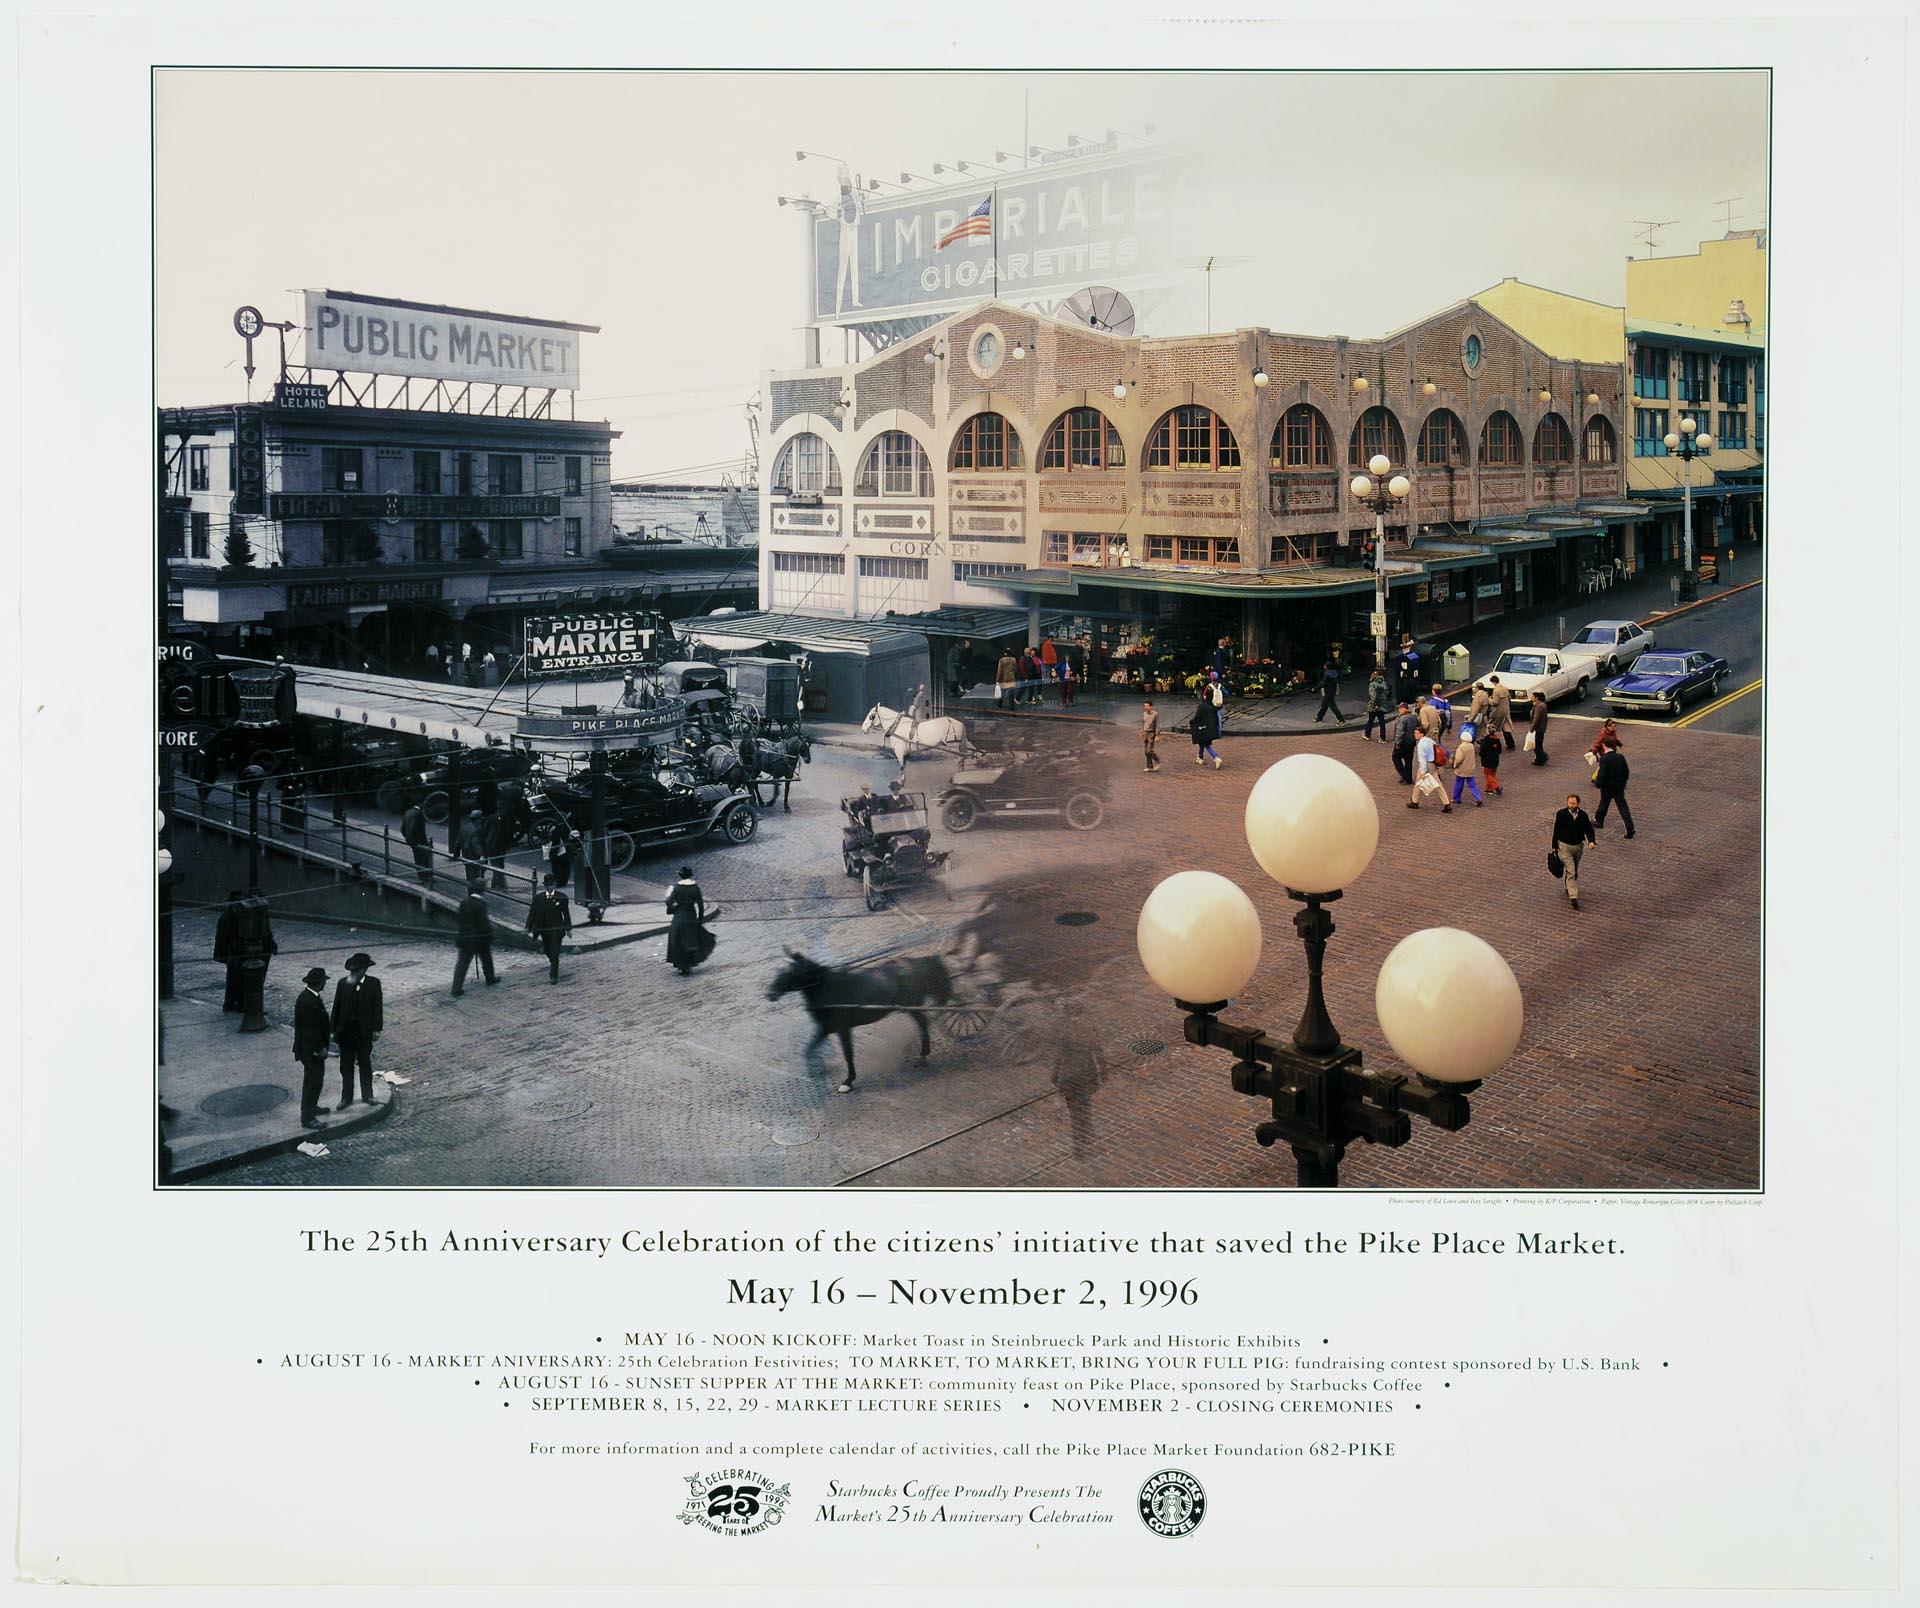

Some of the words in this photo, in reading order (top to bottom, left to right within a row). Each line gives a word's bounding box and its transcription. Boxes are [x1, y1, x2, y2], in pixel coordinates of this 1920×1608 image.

[874, 165, 1197, 275] IMPERIALE
[920, 237, 1140, 293] CIGARETTES
[316, 305, 438, 361] PUBLIC
[448, 322, 572, 374] MARKET
[285, 387, 324, 397] HOTEL
[280, 397, 326, 409] LELAND
[889, 540, 981, 558] CORNER
[551, 617, 634, 634] PUBLIC
[532, 629, 655, 658] MARKET
[158, 646, 193, 661] RUG
[541, 651, 644, 669] ENTRANCE
[240, 685, 273, 696] DRUG
[572, 720, 607, 733] PIKE
[158, 731, 198, 746] TORE
[1512, 1197, 1536, 1205] Printing
[1558, 1197, 1590, 1205] Corporation
[1620, 1197, 1641, 1205] Vintage
[299, 1229, 355, 1252] The
[366, 1229, 428, 1253] 25th
[439, 1229, 612, 1259] Anniversary
[621, 1228, 785, 1253] Celebration
[795, 1229, 826, 1253] of
[832, 1229, 877, 1253] the
[887, 1230, 1002, 1253] citizens’
[1012, 1230, 1139, 1254] initiative
[1149, 1230, 1206, 1254] that
[1215, 1230, 1293, 1254] saved
[1303, 1231, 1348, 1254] the
[1357, 1230, 1421, 1254] Pike
[1431, 1231, 1506, 1255] Place
[1515, 1231, 1625, 1255] Market.
[725, 1278, 795, 1313] May
[809, 1276, 846, 1305] 16
[887, 1277, 1066, 1306] November
[1078, 1279, 1107, 1311] 2,
[1122, 1277, 1199, 1309] 1996
[624, 1332, 668, 1346] MAY
[676, 1331, 695, 1346] 16
[712, 1333, 766, 1347] NOON
[772, 1333, 857, 1347] KICKOFF:
[863, 1333, 918, 1347] Market
[922, 1334, 965, 1347] Toast
[971, 1334, 985, 1347] in
[991, 1333, 1085, 1348] Steinbrueck
[1091, 1334, 1128, 1347] Park
[1133, 1334, 1161, 1348] and
[1167, 1334, 1231, 1348] Historic
[1236, 1334, 1301, 1348] Exhibits
[280, 1353, 365, 1368] AUGUST
[373, 1352, 391, 1368] 16
[408, 1354, 485, 1368] MARKET
[491, 1354, 612, 1368] ANIVERSARY:
[617, 1354, 652, 1368] 25th
[657, 1354, 748, 1368] Celebration
[754, 1354, 839, 1370] Festivities;
[848, 1355, 874, 1369] TO
[879, 1355, 960, 1370] MARKET,
[964, 1355, 990, 1369] TO
[996, 1356, 1076, 1371] MARKET,
[1081, 1356, 1140, 1369] BRING
[1145, 1356, 1197, 1369] YOUR
[1202, 1356, 1248, 1370] FULL
[1253, 1356, 1289, 1370] PIG:
[1295, 1355, 1385, 1374] fundraising
[1390, 1360, 1447, 1370] contest
[1452, 1356, 1532, 1374] sponsored
[1538, 1356, 1556, 1374] by
[1562, 1357, 1594, 1371] U.S.
[1600, 1357, 1641, 1371] Bank
[497, 1375, 583, 1390] AUGUST
[591, 1374, 609, 1390] 16
[625, 1376, 695, 1390] SUNSET
[700, 1376, 768, 1390] SUPPER
[774, 1376, 797, 1390] AT
[801, 1377, 839, 1390] THE
[843, 1376, 923, 1390] MARKET:
[928, 1377, 1017, 1394] community
[1023, 1377, 1059, 1391] feast
[1064, 1381, 1083, 1391] on
[1089, 1377, 1124, 1391] Pike
[1129, 1377, 1176, 1393] Place,
[1181, 1377, 1260, 1395] sponsored
[1266, 1377, 1285, 1395] by
[1289, 1377, 1368, 1392] Starbucks
[1372, 1377, 1423, 1392] Coffee
[531, 1396, 647, 1411] SEPTEMBER
[652, 1397, 668, 1414] 8,
[676, 1397, 700, 1414] 15,
[706, 1397, 732, 1414] 22,
[738, 1397, 759, 1413] 29
[776, 1399, 853, 1412] MARKET
[858, 1399, 938, 1412] LECTURE
[943, 1399, 1002, 1412] SERIES
[1051, 1398, 1164, 1413] NOVEMBER
[1170, 1398, 1179, 1413] 2
[1196, 1399, 1275, 1413] CLOSING
[1280, 1400, 1393, 1414] CEREMONIES
[529, 1441, 556, 1455] For
[561, 1445, 601, 1455] more
[607, 1441, 699, 1455] information
[705, 1441, 733, 1455] and
[739, 1446, 747, 1455] a
[752, 1442, 824, 1459] complete
[829, 1441, 896, 1455] calendar
[900, 1441, 918, 1455] of
[922, 1442, 998, 1457] activities,
[1002, 1442, 1030, 1456] call
[1036, 1442, 1060, 1456] the
[1066, 1442, 1101, 1457] Pike
[1106, 1443, 1148, 1456] Place
[1152, 1442, 1209, 1456] Market
[1214, 1443, 1304, 1457] Foundation
[1309, 1441, 1395, 1457] 682-PIKE
[705, 1468, 775, 1491] CELEBRATING
[1142, 1472, 1203, 1502] STARBUCKS
[826, 1479, 898, 1498] Starbucks
[902, 1479, 951, 1501] Coffee
[953, 1484, 1009, 1502] Proudly
[1013, 1485, 1071, 1498] Presents
[1075, 1484, 1103, 1498] The
[686, 1501, 706, 1510] 1971
[764, 1494, 786, 1508] 1996
[707, 1484, 762, 1519] 25
[814, 1504, 883, 1523] Market’s
[886, 1504, 927, 1524] 25th
[930, 1504, 1024, 1527] Anniversary
[1028, 1504, 1114, 1524] Celebration
[694, 1513, 723, 1536] KEEPING
[725, 1527, 738, 1537] THE
[740, 1520, 770, 1537] MARKET
[1148, 1517, 1196, 1535] COFFEE
